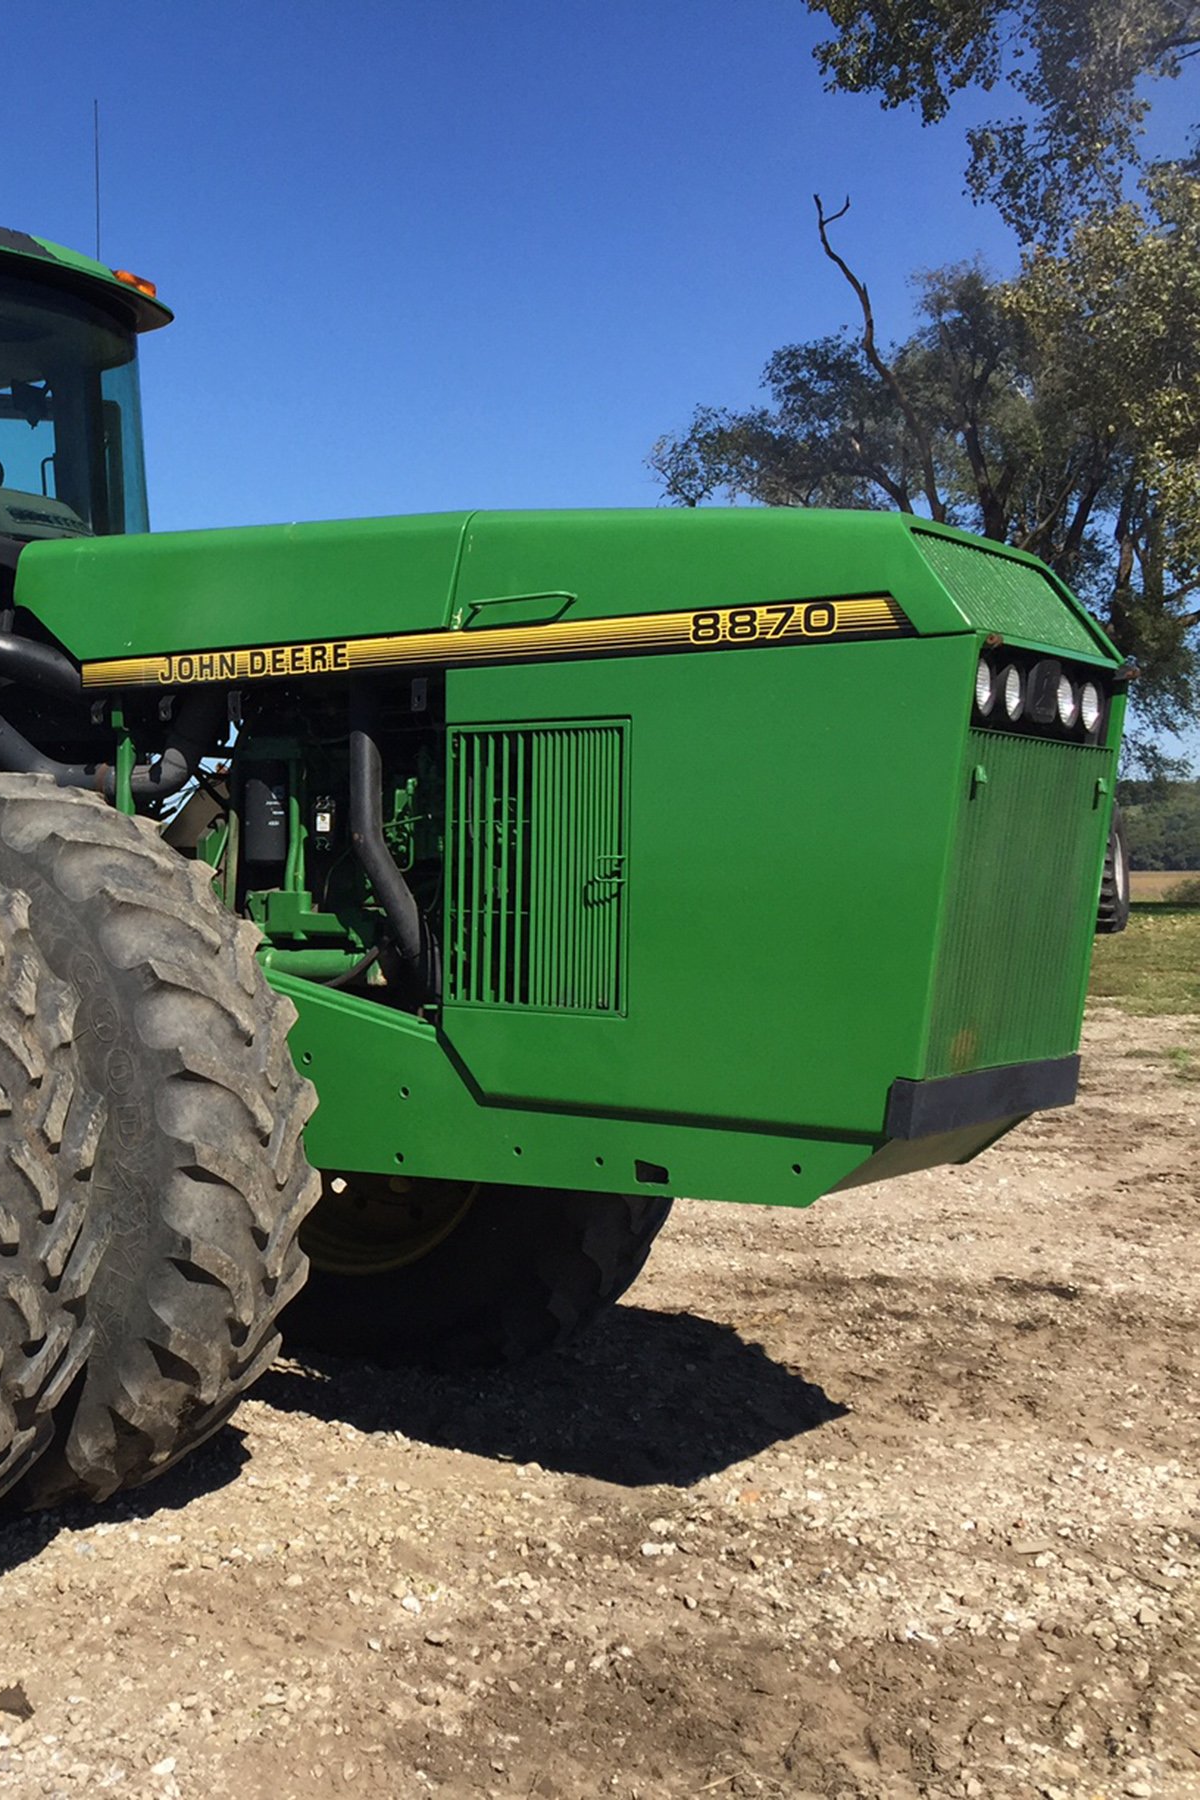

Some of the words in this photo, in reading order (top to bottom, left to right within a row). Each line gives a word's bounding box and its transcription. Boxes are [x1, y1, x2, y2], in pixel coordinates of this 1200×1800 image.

[690, 601, 838, 645] 8870
[159, 653, 237, 684] JOHN
[248, 643, 350, 677] DEERE
